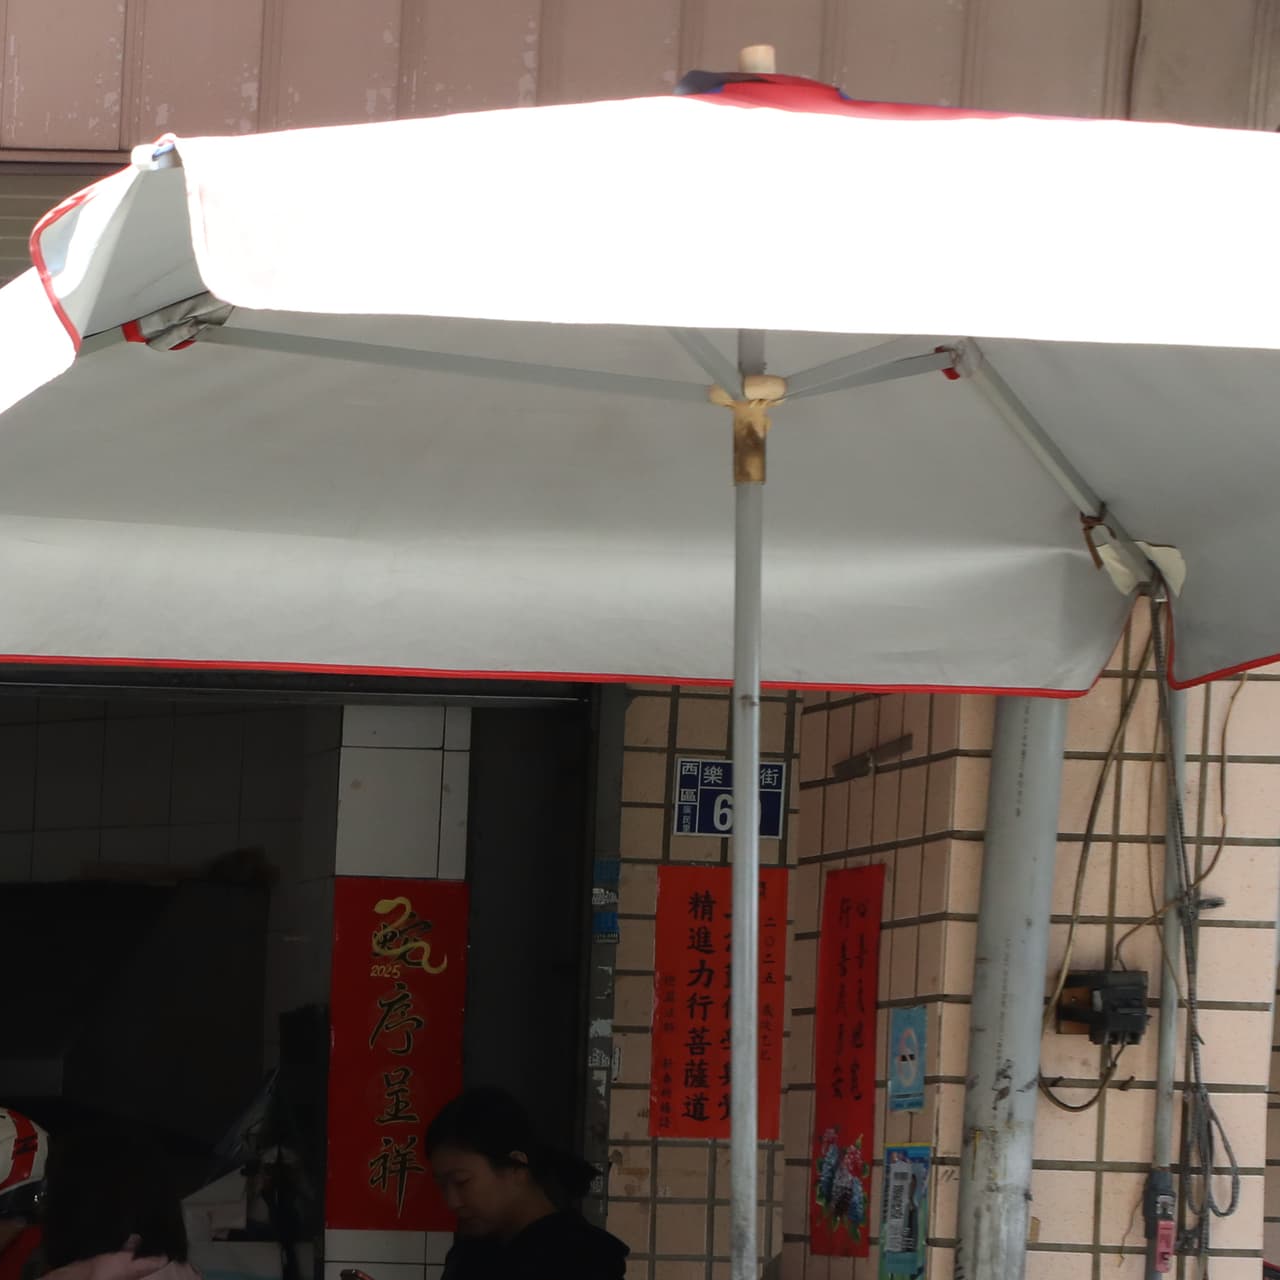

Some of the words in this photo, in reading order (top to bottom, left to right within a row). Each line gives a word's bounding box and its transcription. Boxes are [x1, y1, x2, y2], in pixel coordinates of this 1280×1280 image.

[703, 765, 779, 786] 樂街
[713, 793, 762, 832] 6
[370, 964, 401, 979] 2025
[681, 889, 717, 1122] 精進力行菩薩道
